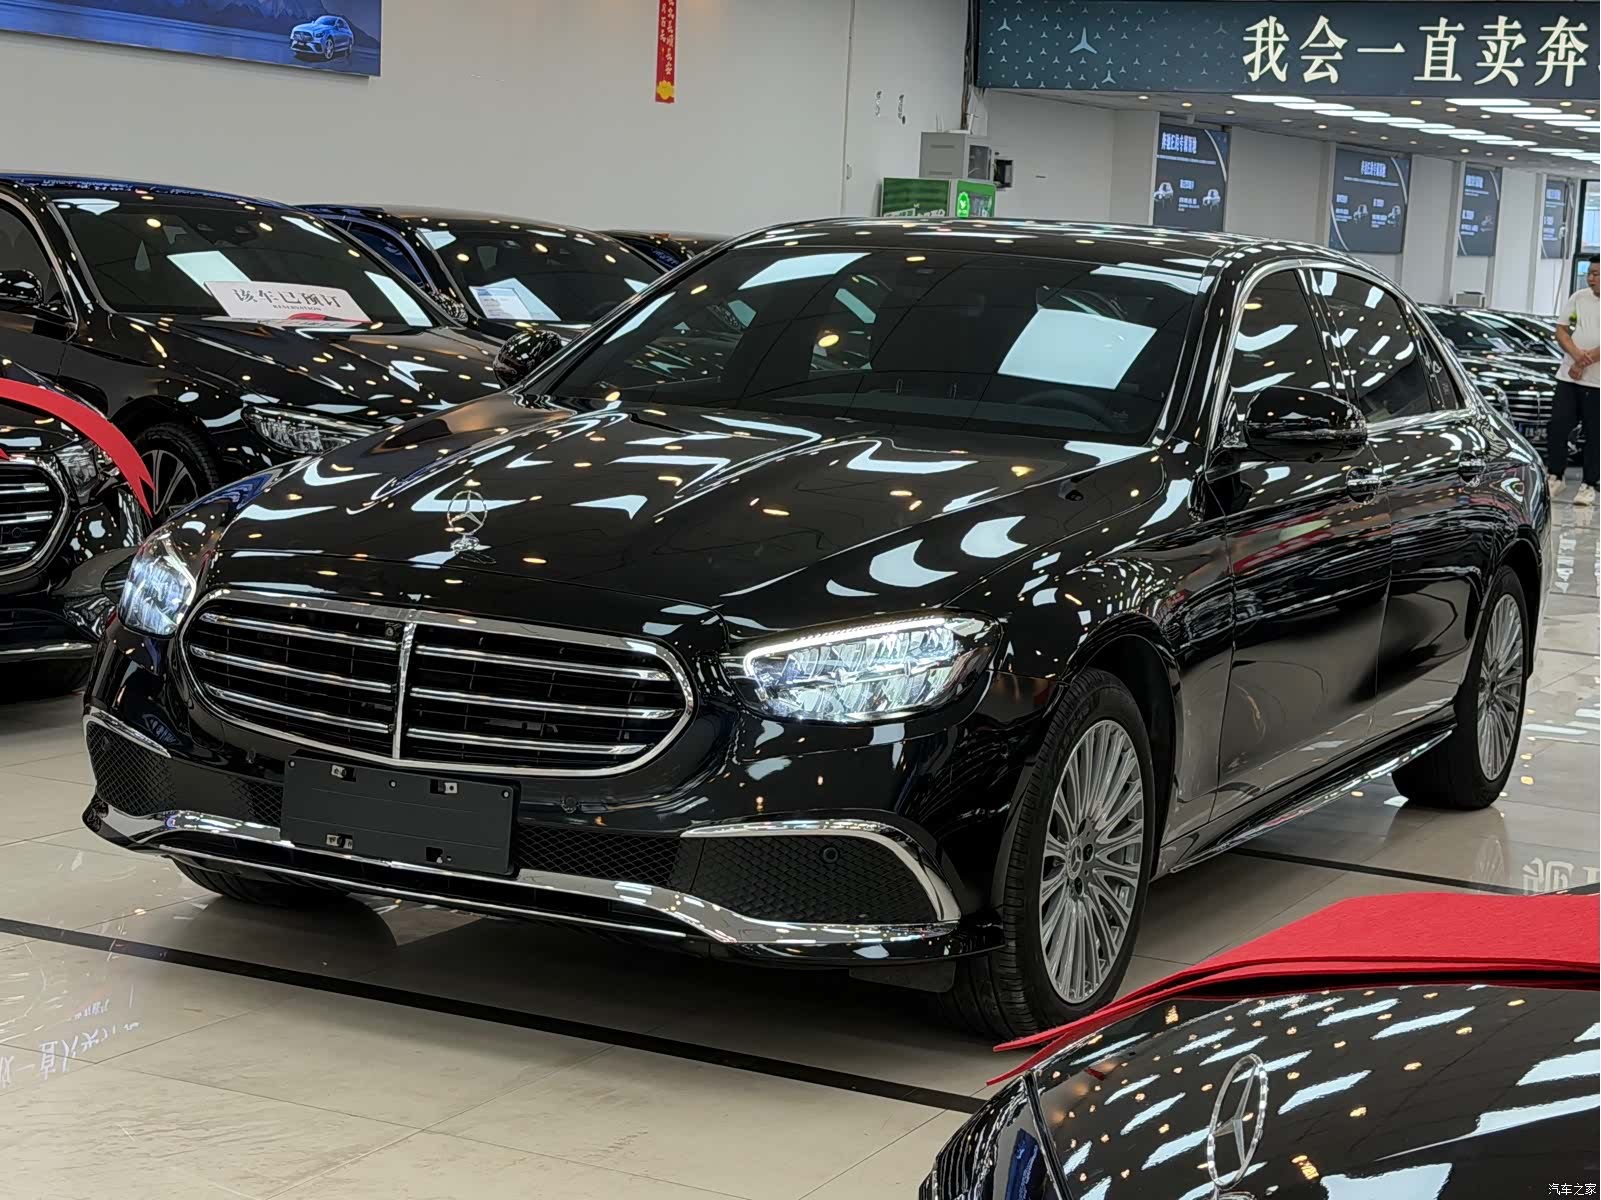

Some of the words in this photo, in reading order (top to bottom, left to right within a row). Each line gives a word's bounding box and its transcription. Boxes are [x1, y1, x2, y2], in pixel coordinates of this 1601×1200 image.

[1243, 15, 1600, 87] 我会一直卖奔
[233, 288, 341, 308] 该车已预订
